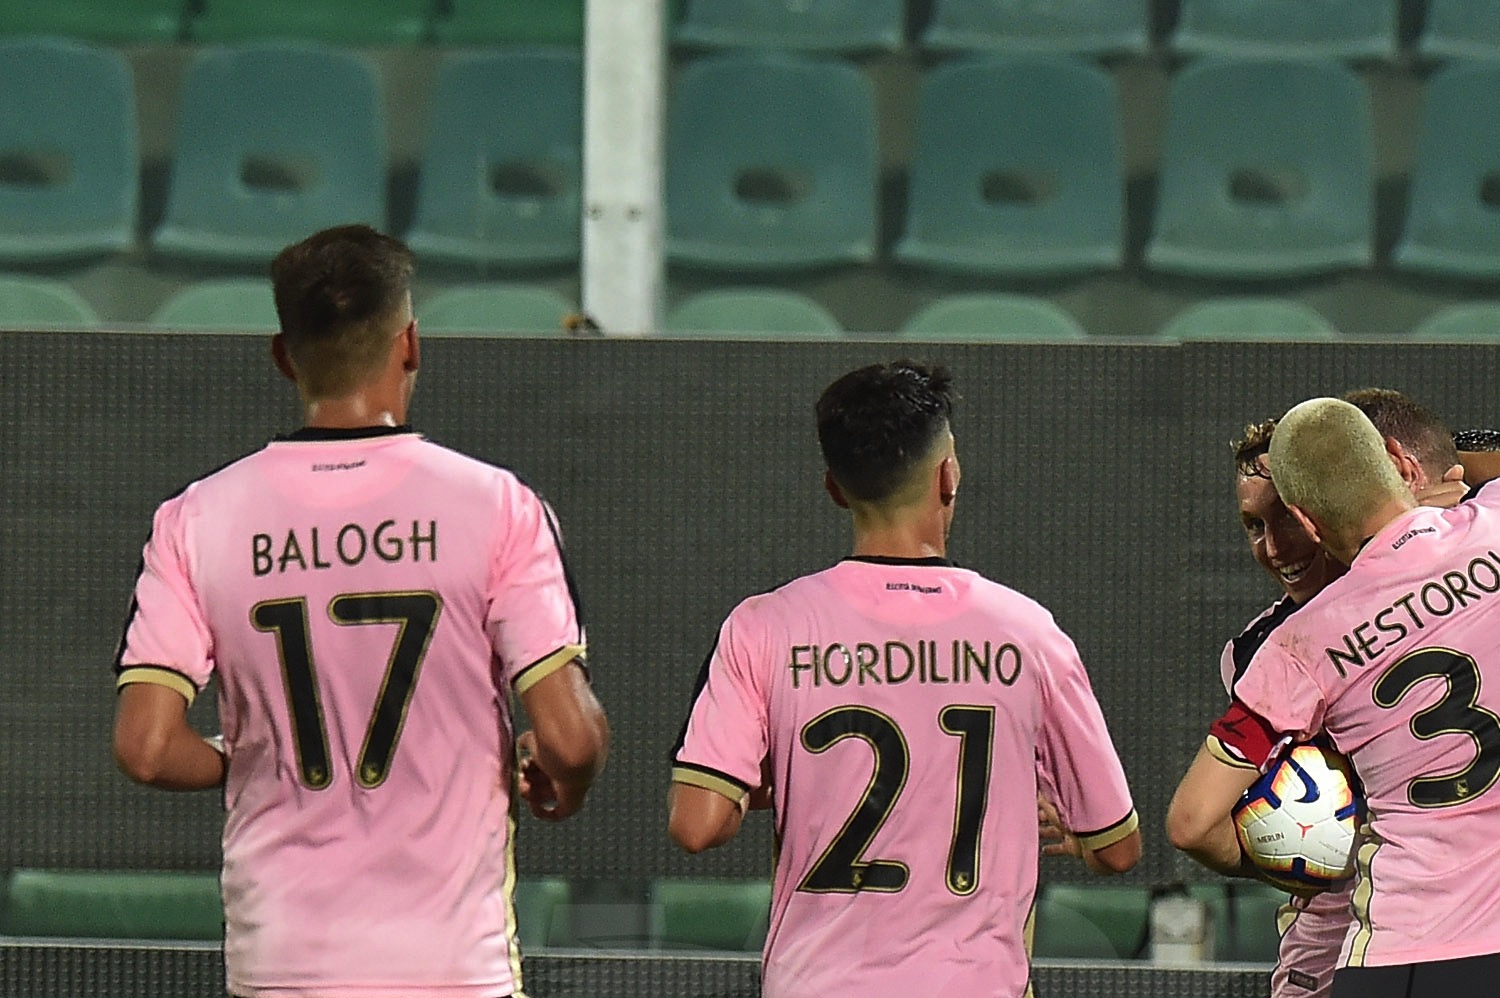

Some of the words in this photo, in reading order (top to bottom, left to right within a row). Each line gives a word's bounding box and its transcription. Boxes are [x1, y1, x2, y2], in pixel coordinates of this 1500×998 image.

[252, 519, 437, 577] BALOGH
[249, 589, 444, 791] 17
[789, 639, 1022, 689] FIORDILINO
[796, 703, 996, 897] 21
[1256, 831, 1286, 844] MERLIN
